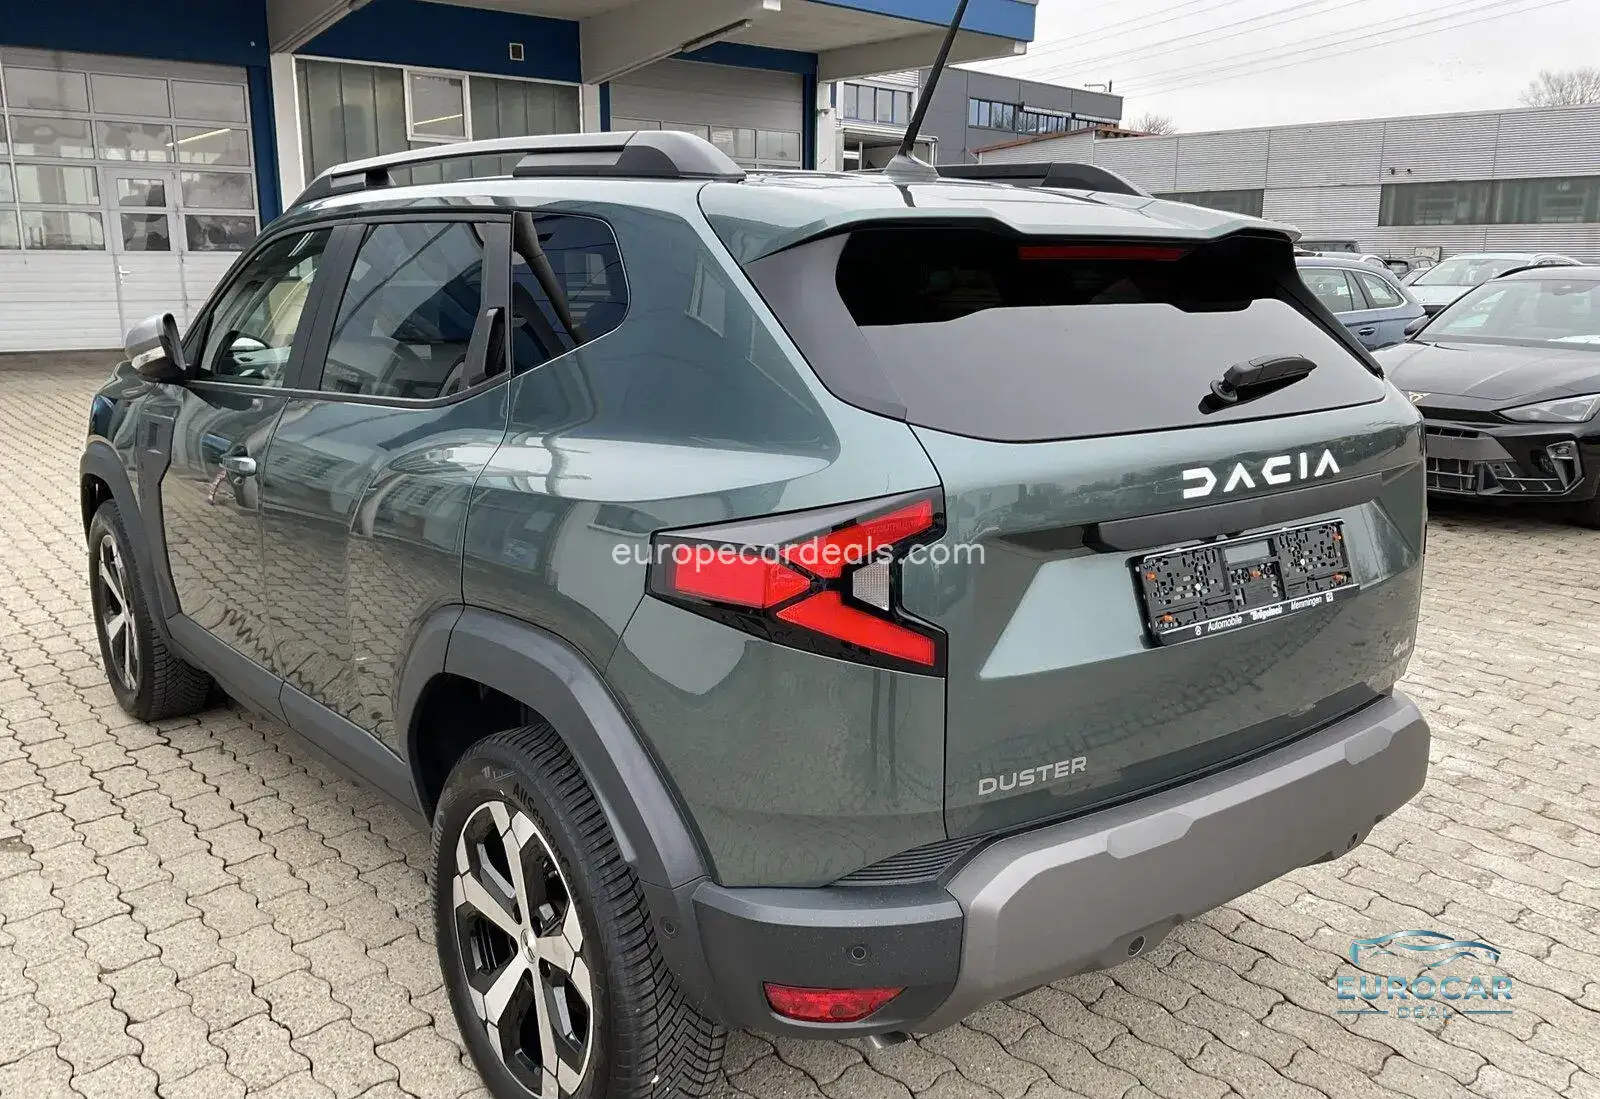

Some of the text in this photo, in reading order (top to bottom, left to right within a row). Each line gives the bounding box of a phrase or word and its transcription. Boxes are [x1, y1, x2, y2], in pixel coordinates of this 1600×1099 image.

[1182, 448, 1341, 500] DACIA
[1207, 596, 1322, 631] Automobile Memmingen
[978, 756, 1087, 795] DUSTER
